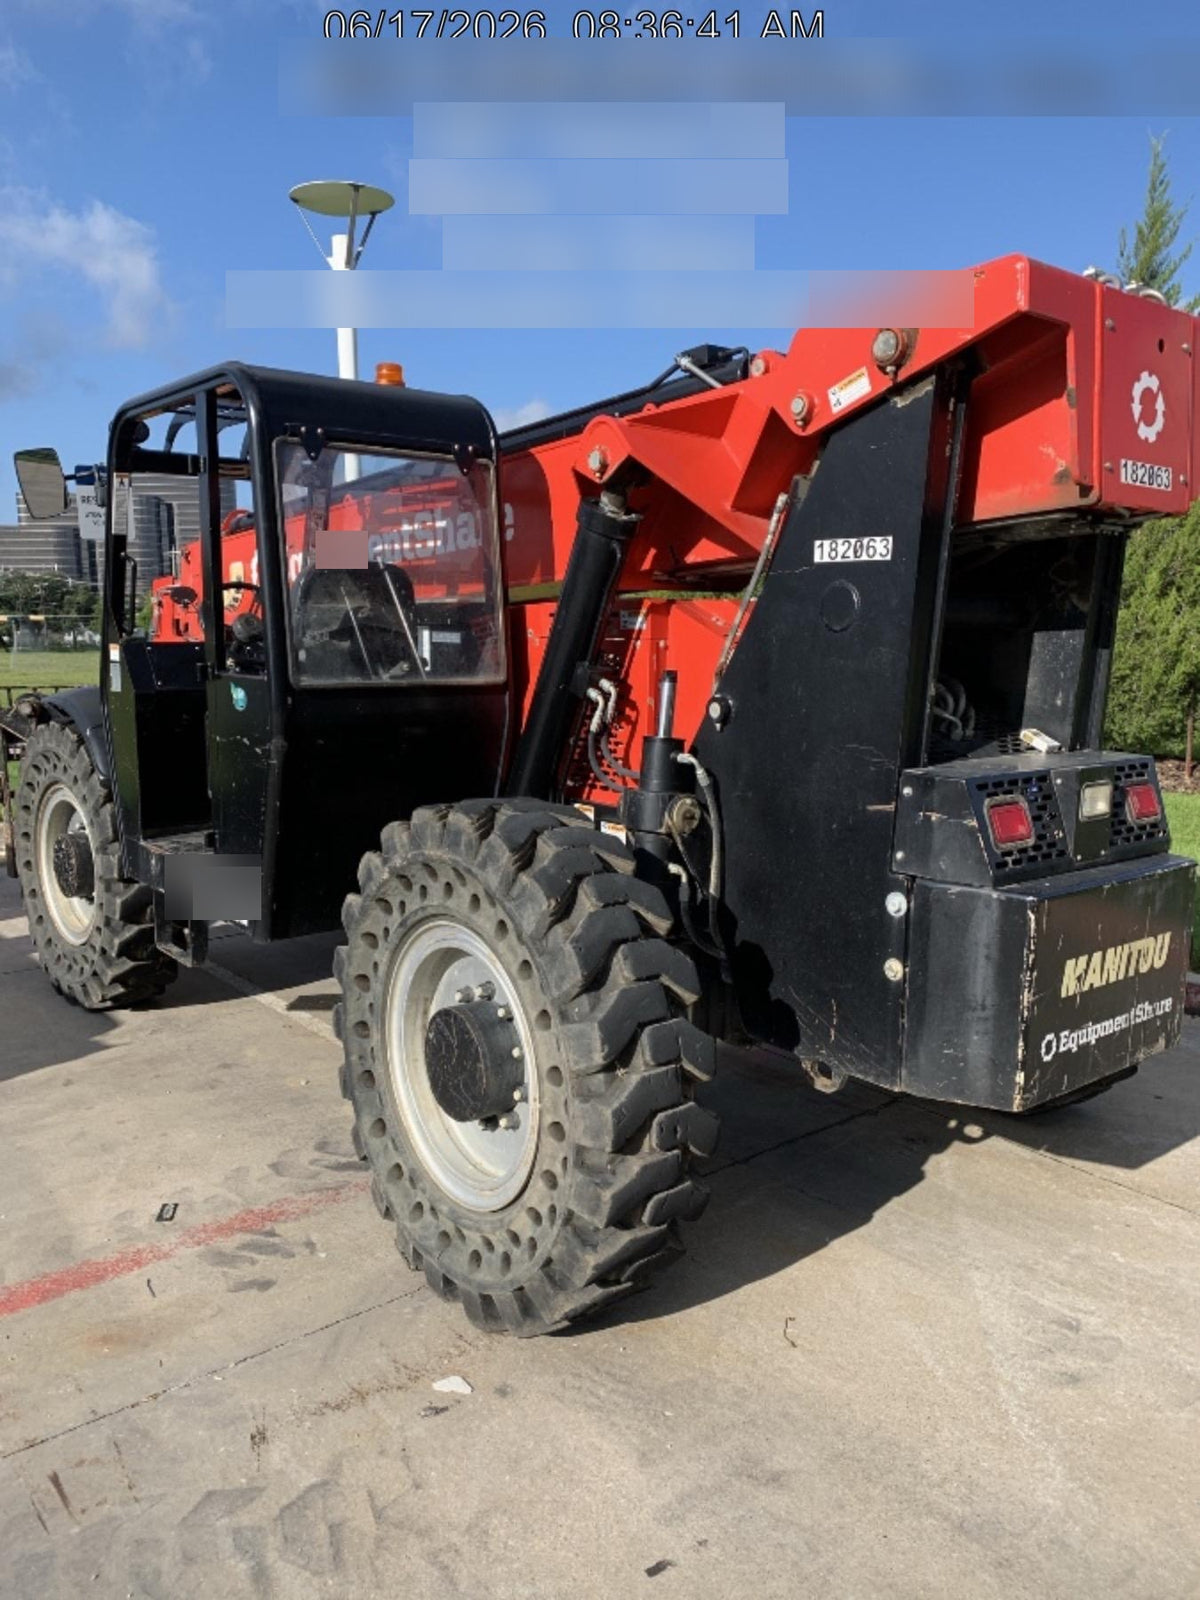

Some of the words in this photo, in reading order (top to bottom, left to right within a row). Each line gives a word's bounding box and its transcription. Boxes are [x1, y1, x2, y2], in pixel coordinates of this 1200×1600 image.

[1122, 460, 1170, 489] 182063
[817, 538, 890, 560] 182063
[1060, 931, 1172, 998] MANITOU
